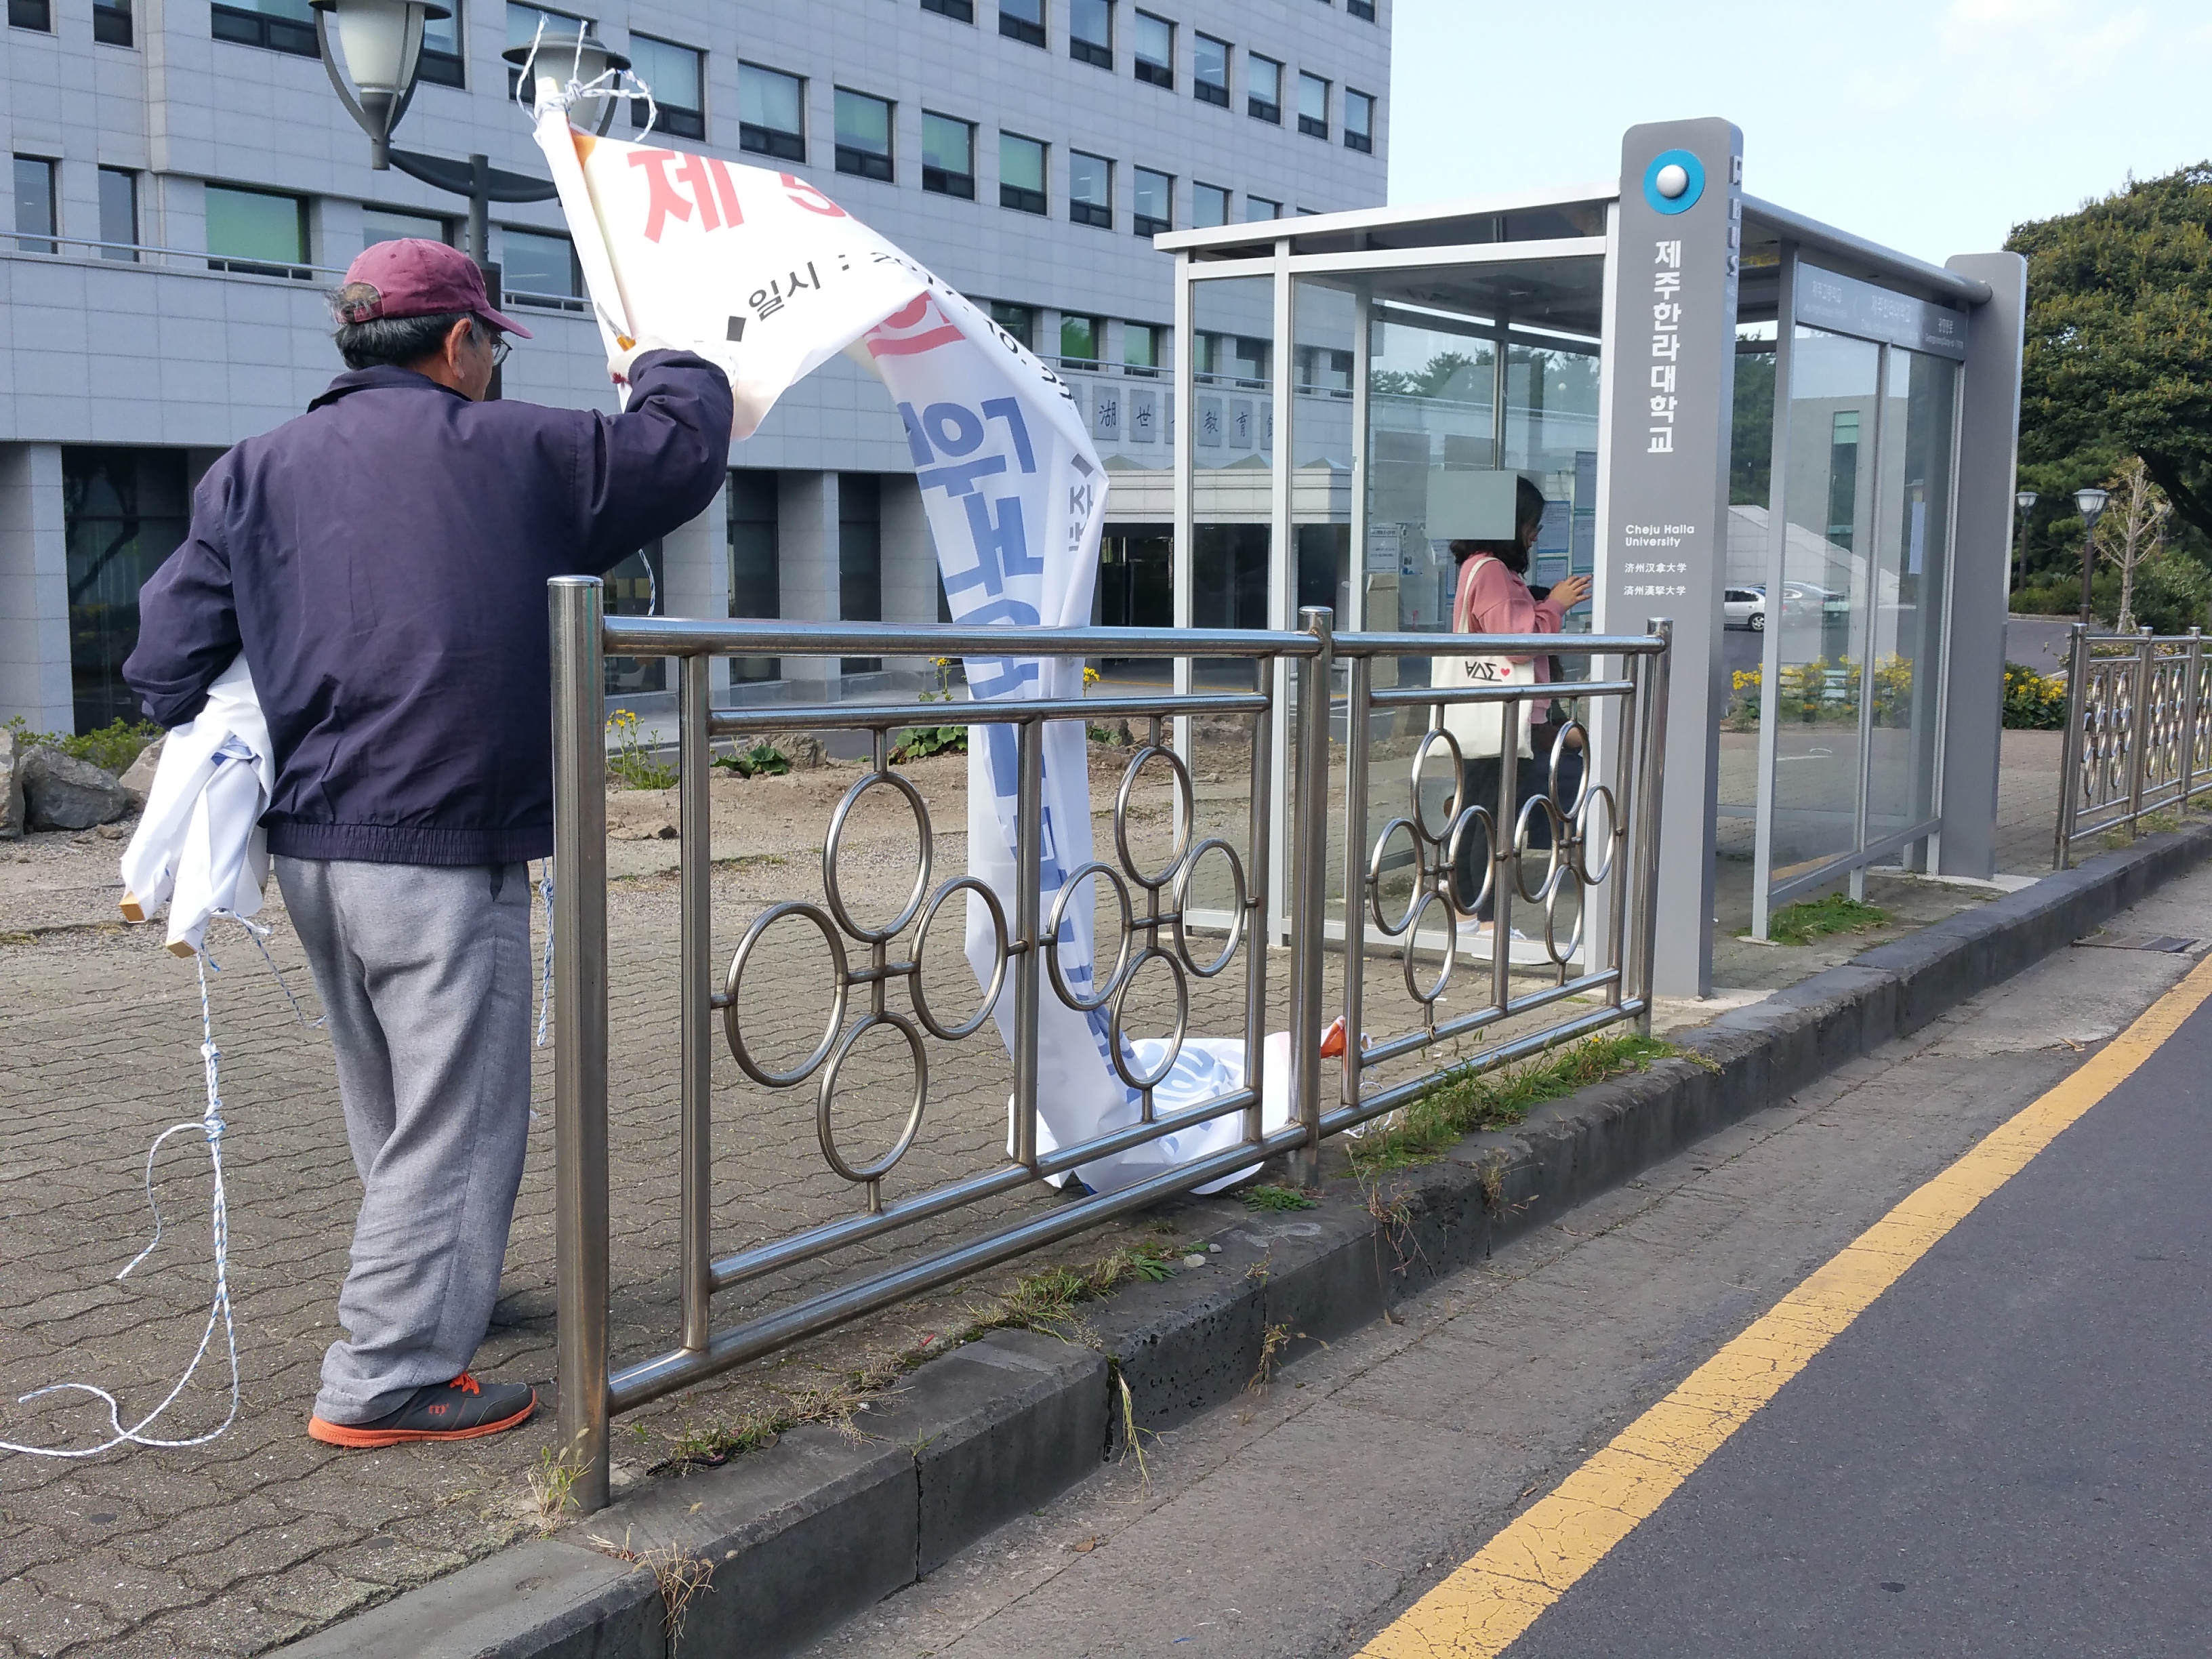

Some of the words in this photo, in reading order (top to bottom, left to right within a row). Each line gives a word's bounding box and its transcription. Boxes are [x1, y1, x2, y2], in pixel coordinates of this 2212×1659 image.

[627, 150, 745, 244] 제
[749, 261, 821, 321] 일시
[1647, 240, 1682, 453] 제주한라대학교
[1625, 525, 1660, 535] Cheju
[1664, 524, 1695, 534] Halla
[1625, 536, 1681, 548] University
[1624, 562, 1687, 573] 济州汉拿大学
